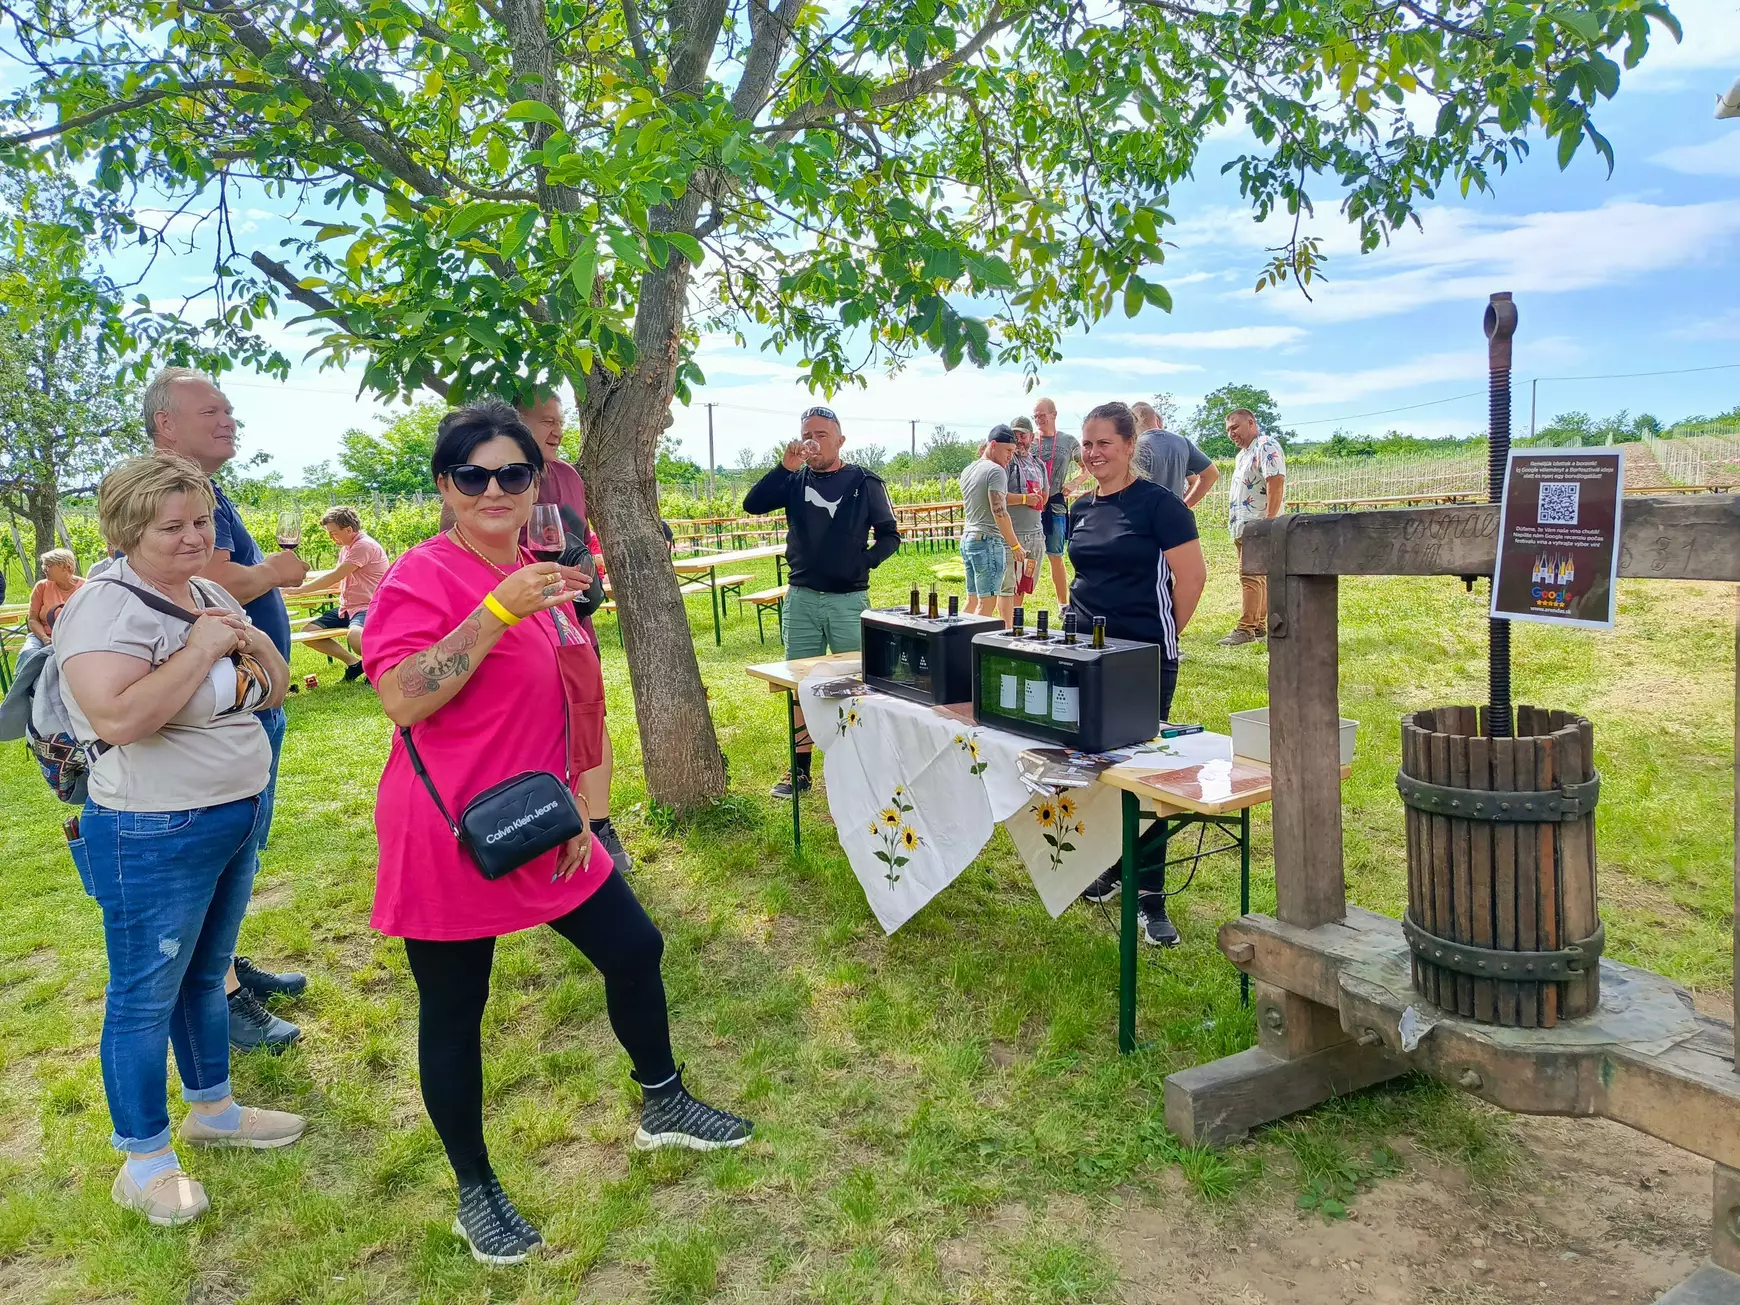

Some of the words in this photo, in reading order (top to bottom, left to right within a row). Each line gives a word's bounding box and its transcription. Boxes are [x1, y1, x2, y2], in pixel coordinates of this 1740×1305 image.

[1531, 586, 1573, 602] Google
[486, 824, 515, 844] Calvin
[512, 814, 535, 829] Klein
[534, 800, 558, 818] Jeans
